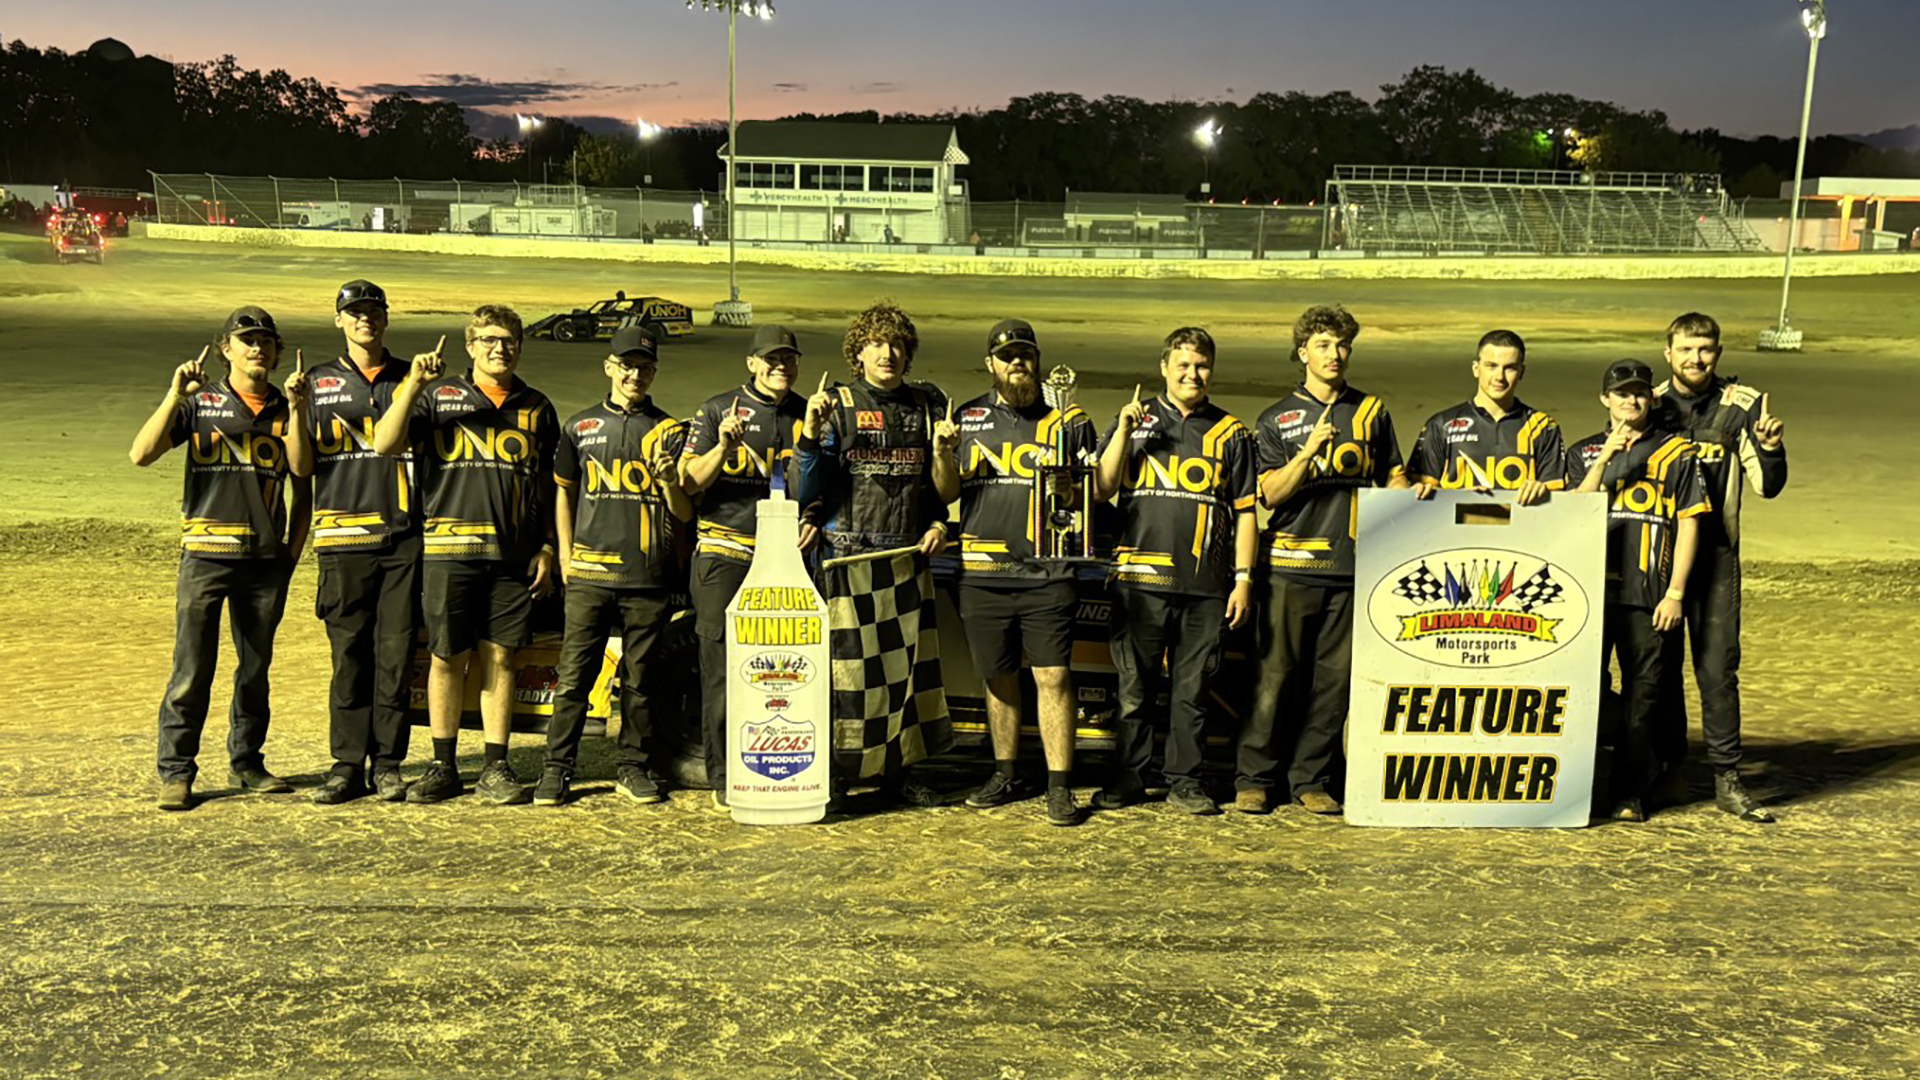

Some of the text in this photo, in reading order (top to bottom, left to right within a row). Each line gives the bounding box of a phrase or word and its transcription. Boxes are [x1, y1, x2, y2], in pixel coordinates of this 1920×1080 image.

[850, 196, 908, 204] MERCYHEALTH
[650, 302, 687, 317] UNOH
[436, 403, 475, 412] LUCAS OIL
[737, 587, 819, 611] FEATURE
[1075, 603, 1112, 620] ING
[1419, 612, 1538, 633] LIMALAND
[734, 615, 822, 646] WINNER
[1435, 637, 1517, 651] Motorsports
[1461, 652, 1490, 664] Park
[1381, 685, 1569, 736] FEATURE
[748, 736, 812, 751] LUCAS
[744, 754, 813, 764] OIL PRODUCTS
[769, 766, 791, 775] INC.
[1381, 753, 1560, 803] WINNER
[733, 784, 751, 792] KEEP
